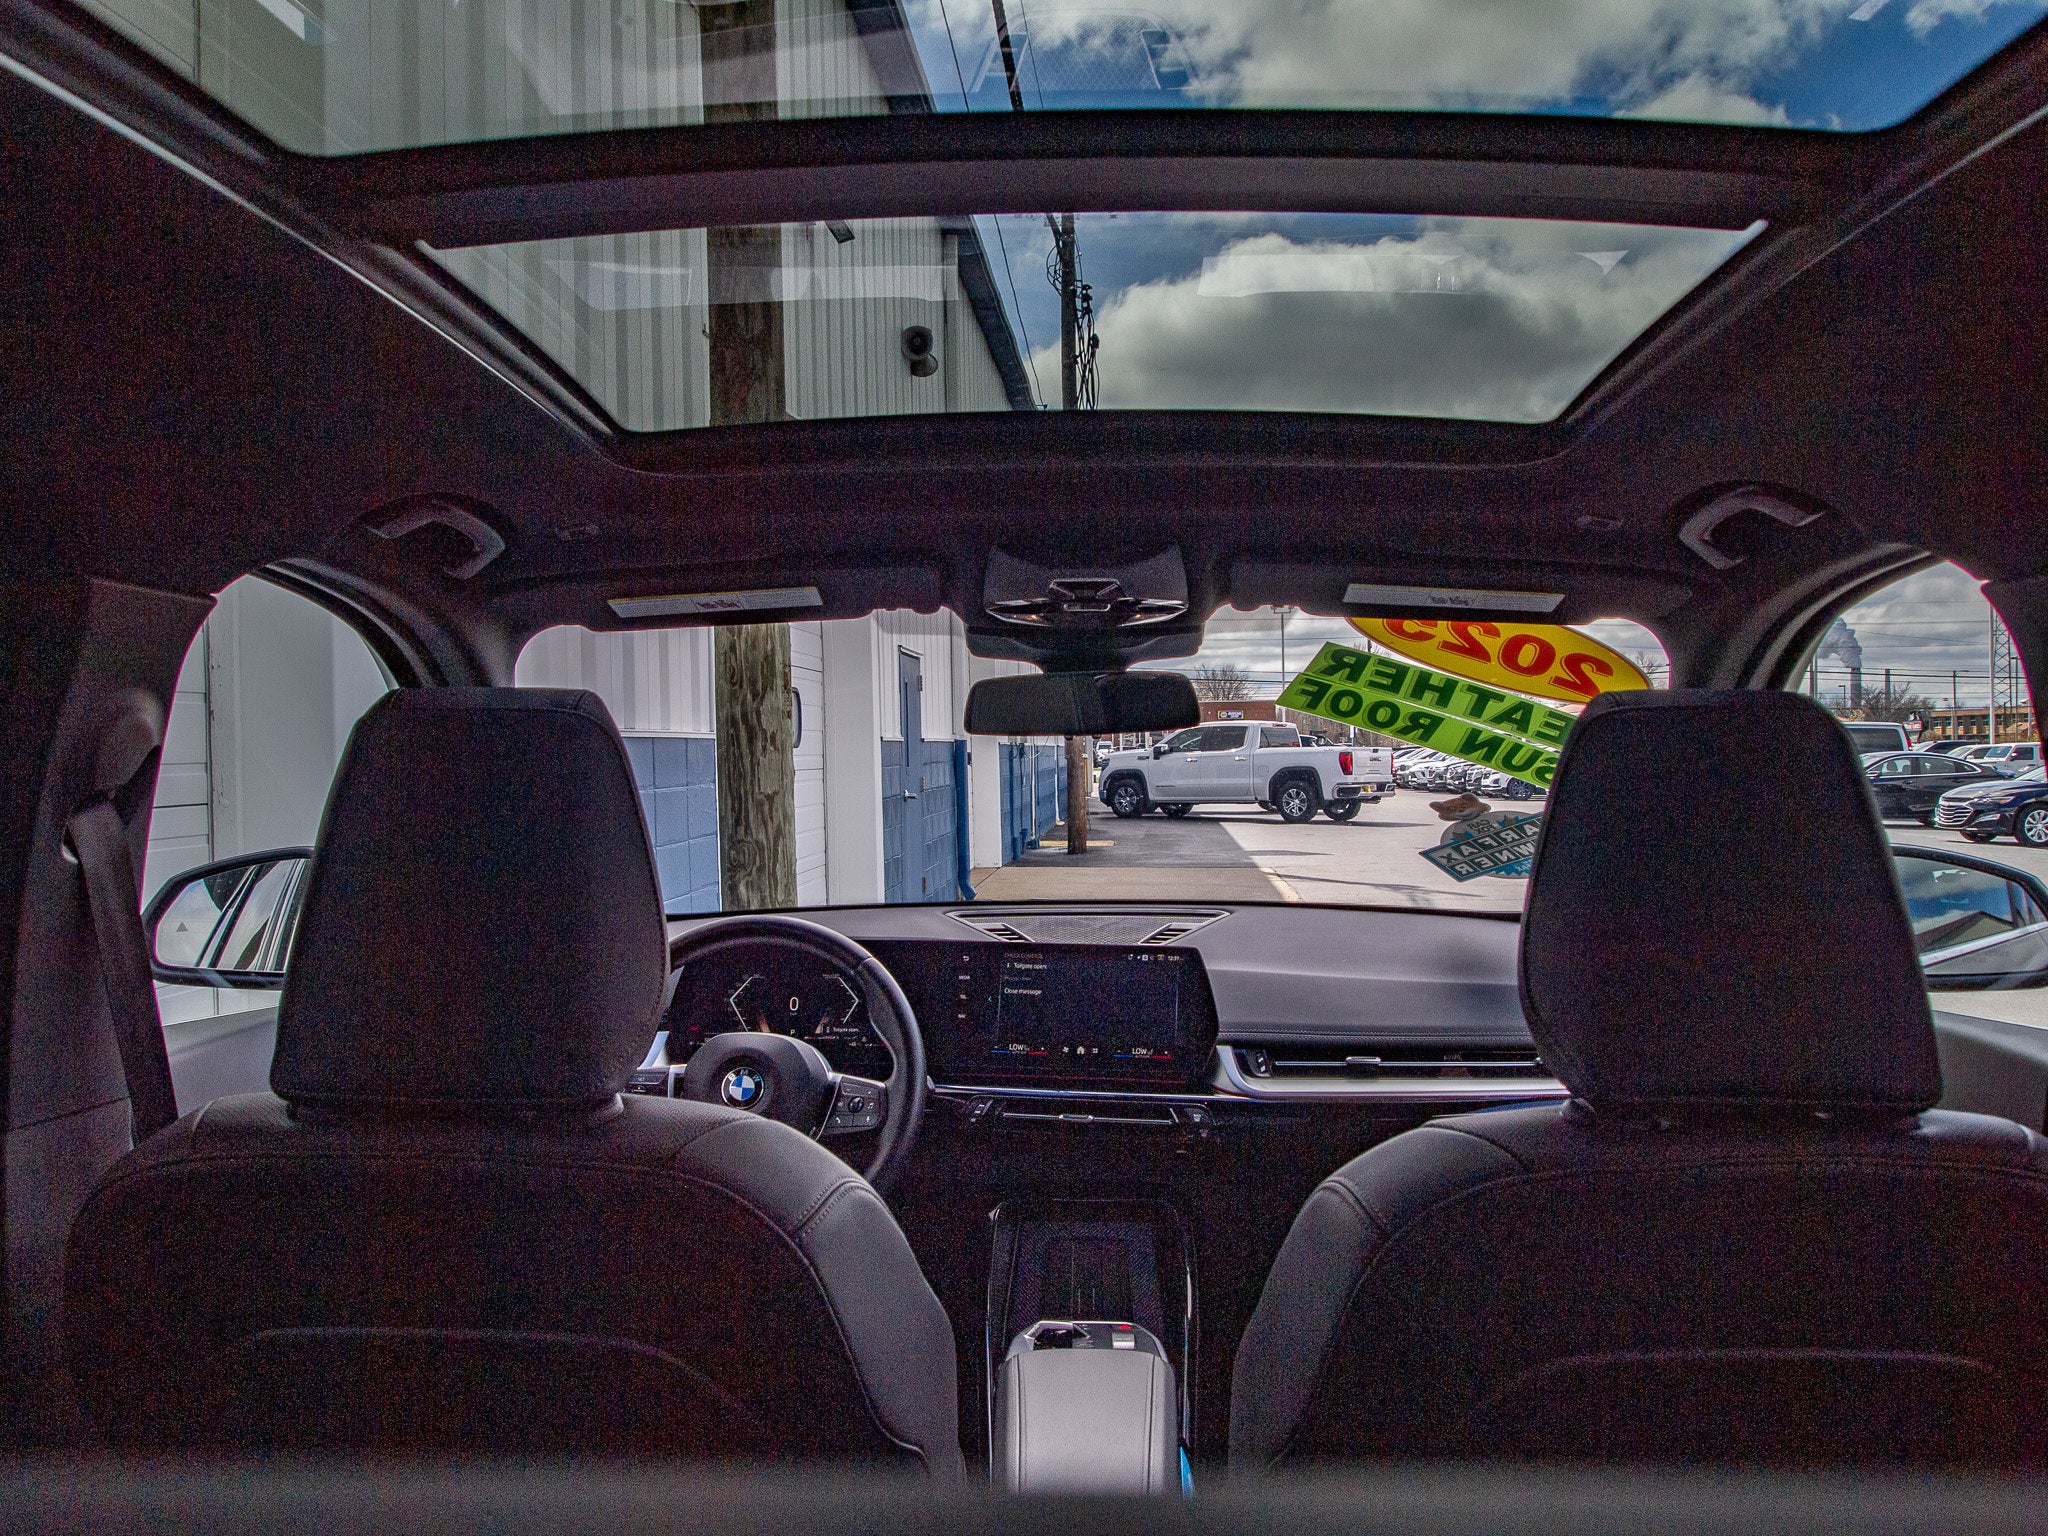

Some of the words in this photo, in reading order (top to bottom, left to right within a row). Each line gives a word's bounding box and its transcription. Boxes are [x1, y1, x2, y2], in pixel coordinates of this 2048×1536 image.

[1013, 962, 1033, 970] Tailgate
[1018, 988, 1042, 996] message
[789, 997, 799, 1011] 0
[1009, 1043, 1024, 1051] LOW
